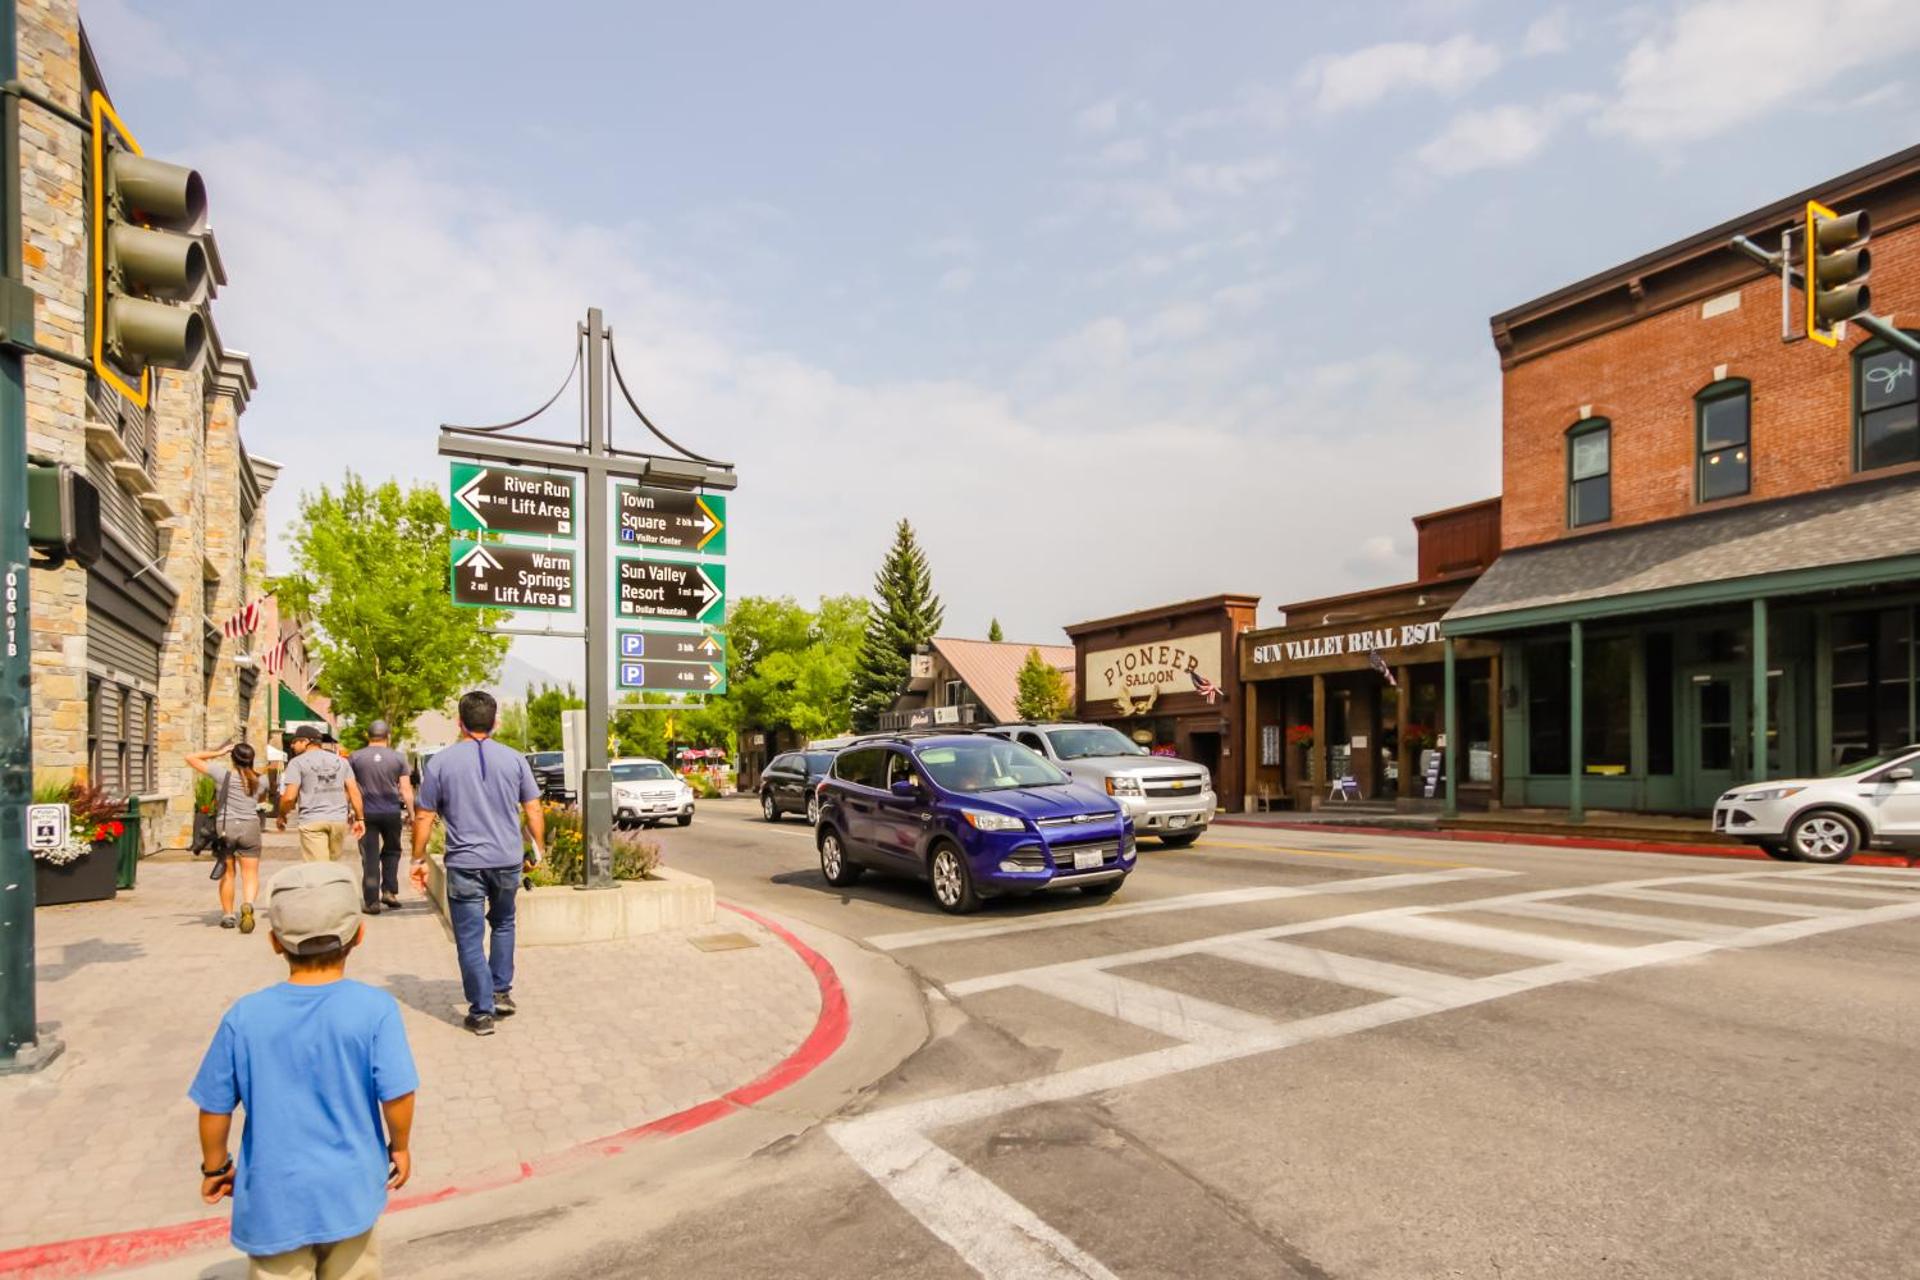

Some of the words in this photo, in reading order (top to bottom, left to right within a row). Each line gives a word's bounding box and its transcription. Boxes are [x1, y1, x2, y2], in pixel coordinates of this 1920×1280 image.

[504, 476, 541, 494] River
[544, 481, 570, 498] Run
[493, 495, 497, 503] 1
[498, 496, 508, 505] mi
[621, 492, 654, 509] Town
[511, 499, 536, 515] Lift
[538, 502, 570, 519] Area
[621, 512, 666, 530] Square
[676, 517, 681, 526] 2
[635, 533, 658, 543] Visitor
[660, 536, 681, 545] Center
[532, 553, 570, 571] Warm
[518, 570, 570, 590] Springs
[621, 564, 646, 579] Sun
[649, 565, 686, 585] Valley
[470, 581, 477, 590] 2
[478, 582, 488, 591] mi
[621, 584, 665, 600] Resort
[678, 587, 682, 595] 1
[682, 588, 692, 596] mi
[495, 587, 520, 603] Lift
[523, 589, 556, 605] Area
[6, 572, 17, 656] 00601B
[635, 604, 655, 614] Dollar
[657, 606, 687, 616] Mountain
[627, 637, 640, 653] P
[1253, 643, 1283, 664] SUN
[1286, 635, 1346, 660] VALLEY
[1348, 628, 1397, 653] REAL
[627, 666, 640, 682] P
[1104, 646, 1199, 688] PIONEER
[677, 672, 683, 680] 4
[1126, 670, 1174, 687] SALOON
